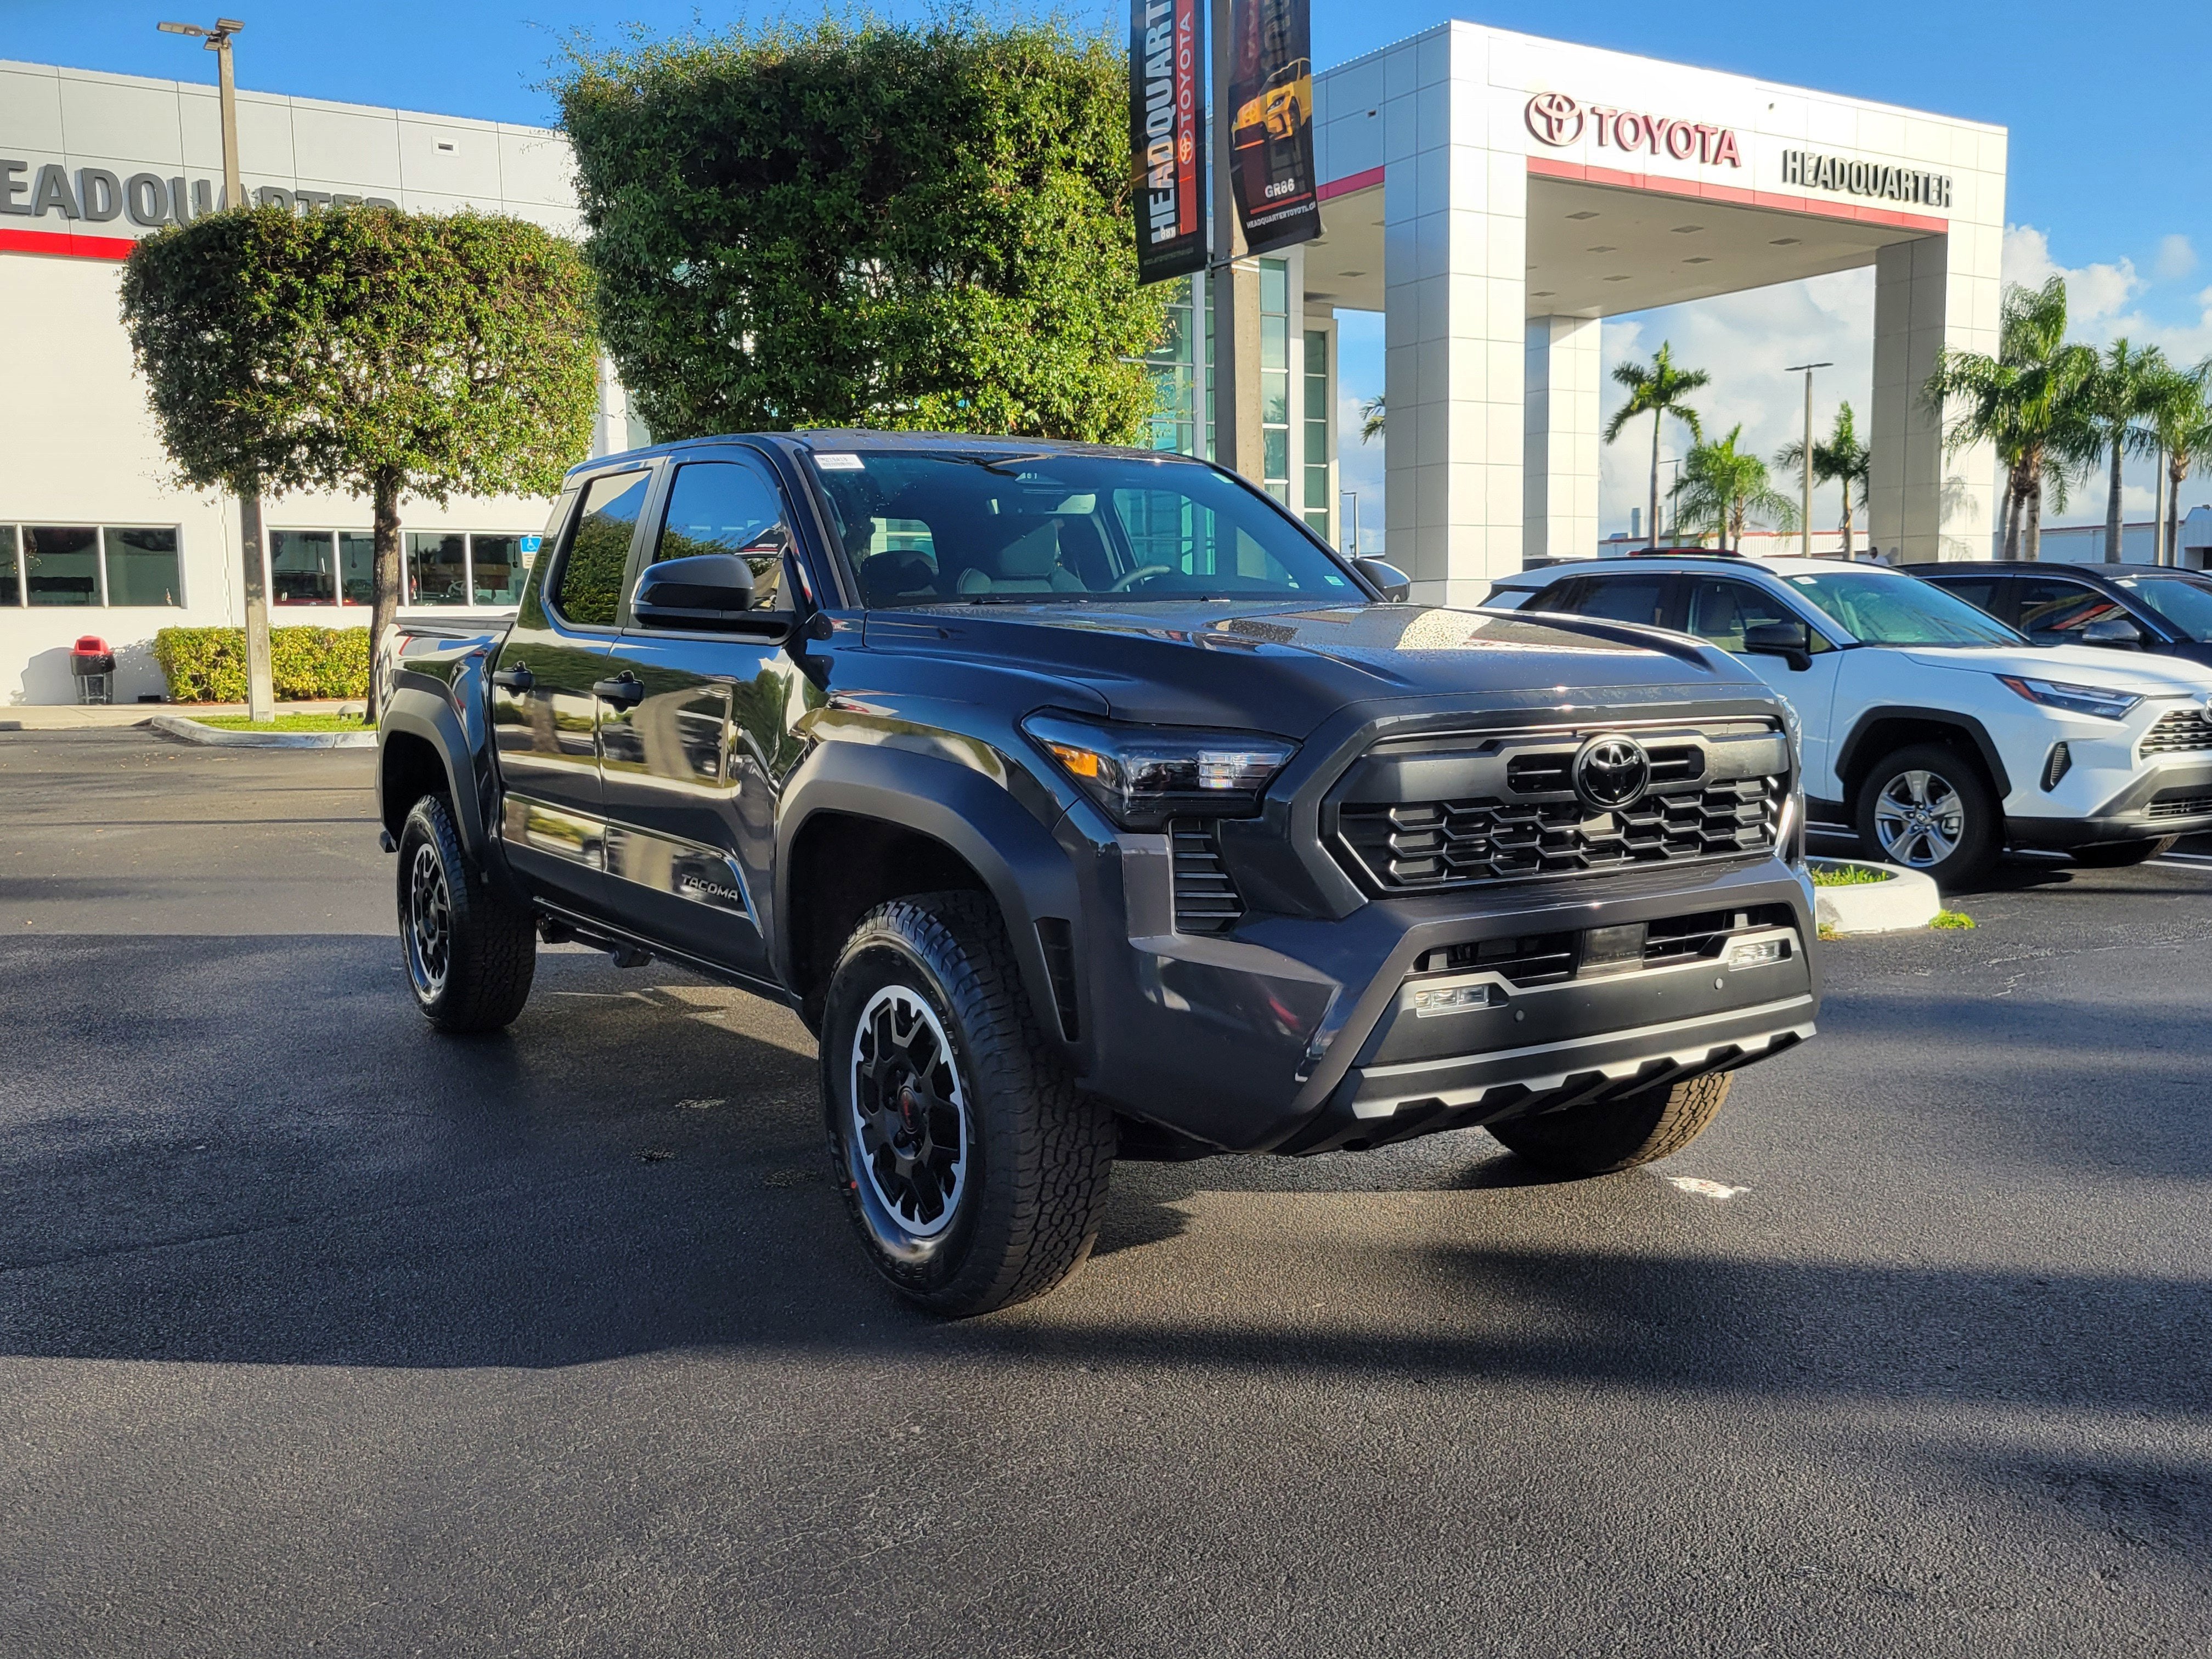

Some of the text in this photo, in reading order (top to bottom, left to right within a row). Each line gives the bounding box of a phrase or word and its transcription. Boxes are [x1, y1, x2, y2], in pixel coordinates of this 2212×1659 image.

[1179, 12, 1191, 128] TOYOTA
[1145, 0, 1176, 244] HEADQUART
[1590, 106, 1953, 208] TOYOTA HEADQUARTER
[1264, 178, 1295, 198] GR86
[681, 873, 738, 901] TACOMA
